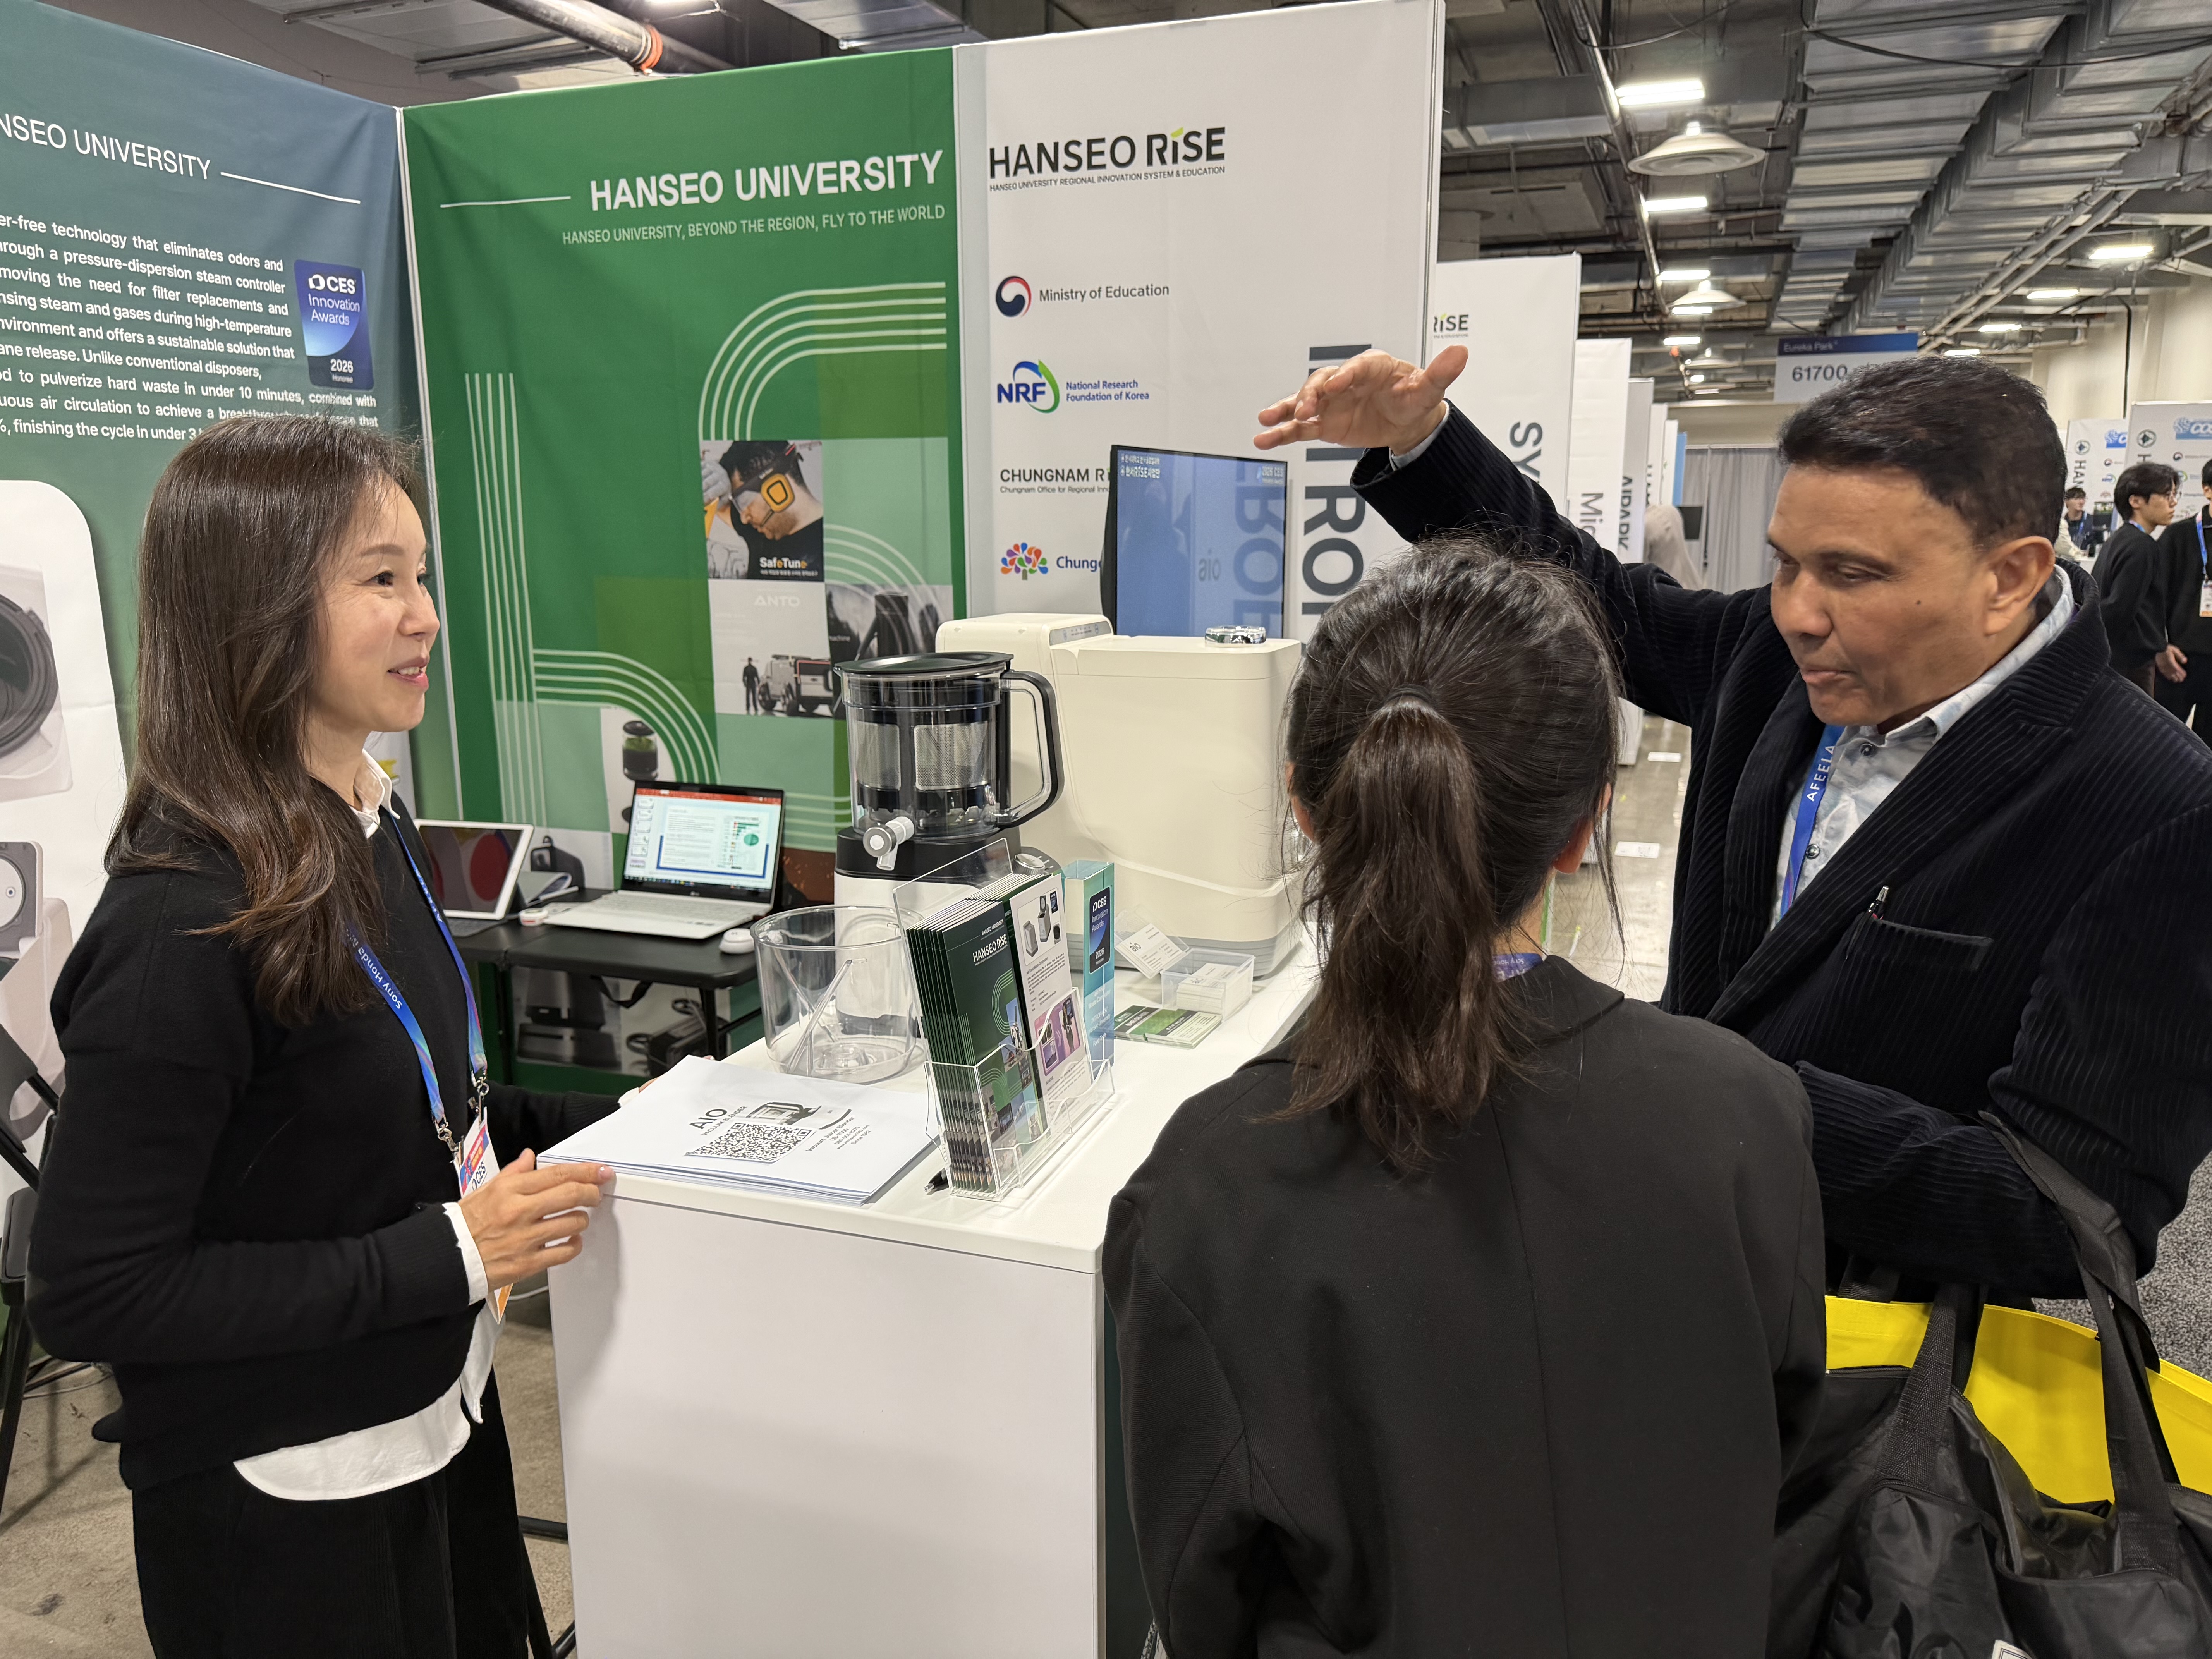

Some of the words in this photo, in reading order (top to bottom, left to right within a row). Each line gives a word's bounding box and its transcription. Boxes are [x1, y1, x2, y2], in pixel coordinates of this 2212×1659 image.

[74, 129, 210, 180] UNIVERSITY
[990, 136, 1135, 179] HANSEO
[591, 170, 723, 211] HANSEO
[735, 149, 943, 201] UNIVERSITY
[990, 182, 1018, 191] HANSEO
[1018, 179, 1058, 189] UNIVERSITY
[1060, 176, 1096, 185] REGIONAL
[1097, 173, 1142, 183] INNOVATION
[1144, 170, 1174, 180] SYSTEM
[1182, 167, 1225, 177] EDUCATION
[563, 229, 610, 244] HANSEO
[614, 225, 685, 242] UNIVERSITY,
[688, 221, 736, 237] BEYOND
[740, 219, 764, 234] THE
[768, 215, 819, 232] REGION,
[823, 213, 845, 229] FLY
[848, 212, 866, 226] TO
[869, 210, 894, 225] THE
[897, 205, 945, 222] WORLD
[52, 222, 127, 249] technology
[132, 236, 159, 252] that
[163, 241, 223, 262] eliminates
[228, 253, 260, 268] odors
[264, 259, 283, 271] and
[50, 249, 58, 260] a
[64, 251, 192, 280] pressure-dispersion
[196, 270, 232, 285] steam
[236, 277, 285, 294] controller
[57, 273, 81, 288] the
[89, 280, 121, 294] need
[128, 282, 146, 297] for
[152, 285, 180, 301] filter
[187, 292, 263, 313] replacements
[268, 304, 289, 316] and
[326, 276, 356, 294] CES
[1039, 289, 1086, 302] Ministry
[1089, 287, 1102, 299] of
[1106, 284, 1169, 298] Education
[308, 294, 360, 312] Innovation
[40, 297, 82, 313] steam
[86, 303, 110, 316] and
[113, 307, 151, 321] gases
[154, 309, 193, 329] during
[195, 314, 292, 337] high-temperature
[311, 309, 350, 326] Awards
[79, 326, 103, 340] and
[106, 328, 144, 344] offers
[147, 335, 155, 345] a
[158, 335, 224, 352] sustainable
[227, 342, 271, 357] solution
[272, 345, 295, 359] that
[1783, 343, 1812, 352] Eureka
[26, 345, 80, 362] release.
[82, 349, 123, 365] Unlike
[126, 356, 203, 373] conventional
[205, 361, 261, 380] disposers,
[330, 358, 354, 373] 2026
[1792, 364, 1847, 382] 61700
[19, 369, 34, 383] to
[41, 372, 102, 388] pulverize
[107, 376, 136, 391] hard
[142, 381, 179, 394] waste
[184, 381, 195, 395] in
[201, 385, 234, 398] under
[239, 386, 252, 399] 10
[257, 388, 304, 405] minutes,
[309, 392, 352, 406] combined
[356, 395, 376, 407] with
[997, 383, 1046, 403] NRF
[1066, 381, 1100, 390] National
[1102, 380, 1138, 389] Research
[1066, 393, 1111, 402] Foundation
[1114, 392, 1123, 400] of
[1125, 392, 1149, 400] Korea
[40, 396, 57, 409] air
[64, 397, 132, 414] circulation
[137, 402, 150, 415] to
[156, 404, 202, 418] achieve
[207, 409, 214, 419] a
[13, 419, 74, 438] finishing
[76, 422, 98, 436] the
[101, 424, 134, 440] cycle
[137, 425, 148, 438] in
[151, 427, 186, 440] under
[189, 428, 196, 440] 3
[1000, 468, 1089, 482] CHUNGNAM
[1068, 486, 1095, 494] Regional
[759, 557, 808, 569] SafeTune
[754, 595, 800, 607] ANTO
[1807, 746, 1835, 802] AFEELA
[1097, 896, 1107, 909] CES
[991, 919, 1004, 930] UNIVERSITY
[1092, 909, 1108, 923] Innovation
[1092, 920, 1104, 933] Awards
[973, 941, 996, 962] HANSEO
[1096, 947, 1104, 960] 2026
[1130, 942, 1141, 952] aio
[358, 947, 383, 983] Honda
[383, 982, 402, 1009] Sony
[689, 1109, 727, 1129] AIO
[701, 1121, 725, 1135] VACUUM
[722, 1106, 747, 1121] BLENDER
[476, 1161, 486, 1185] CES
